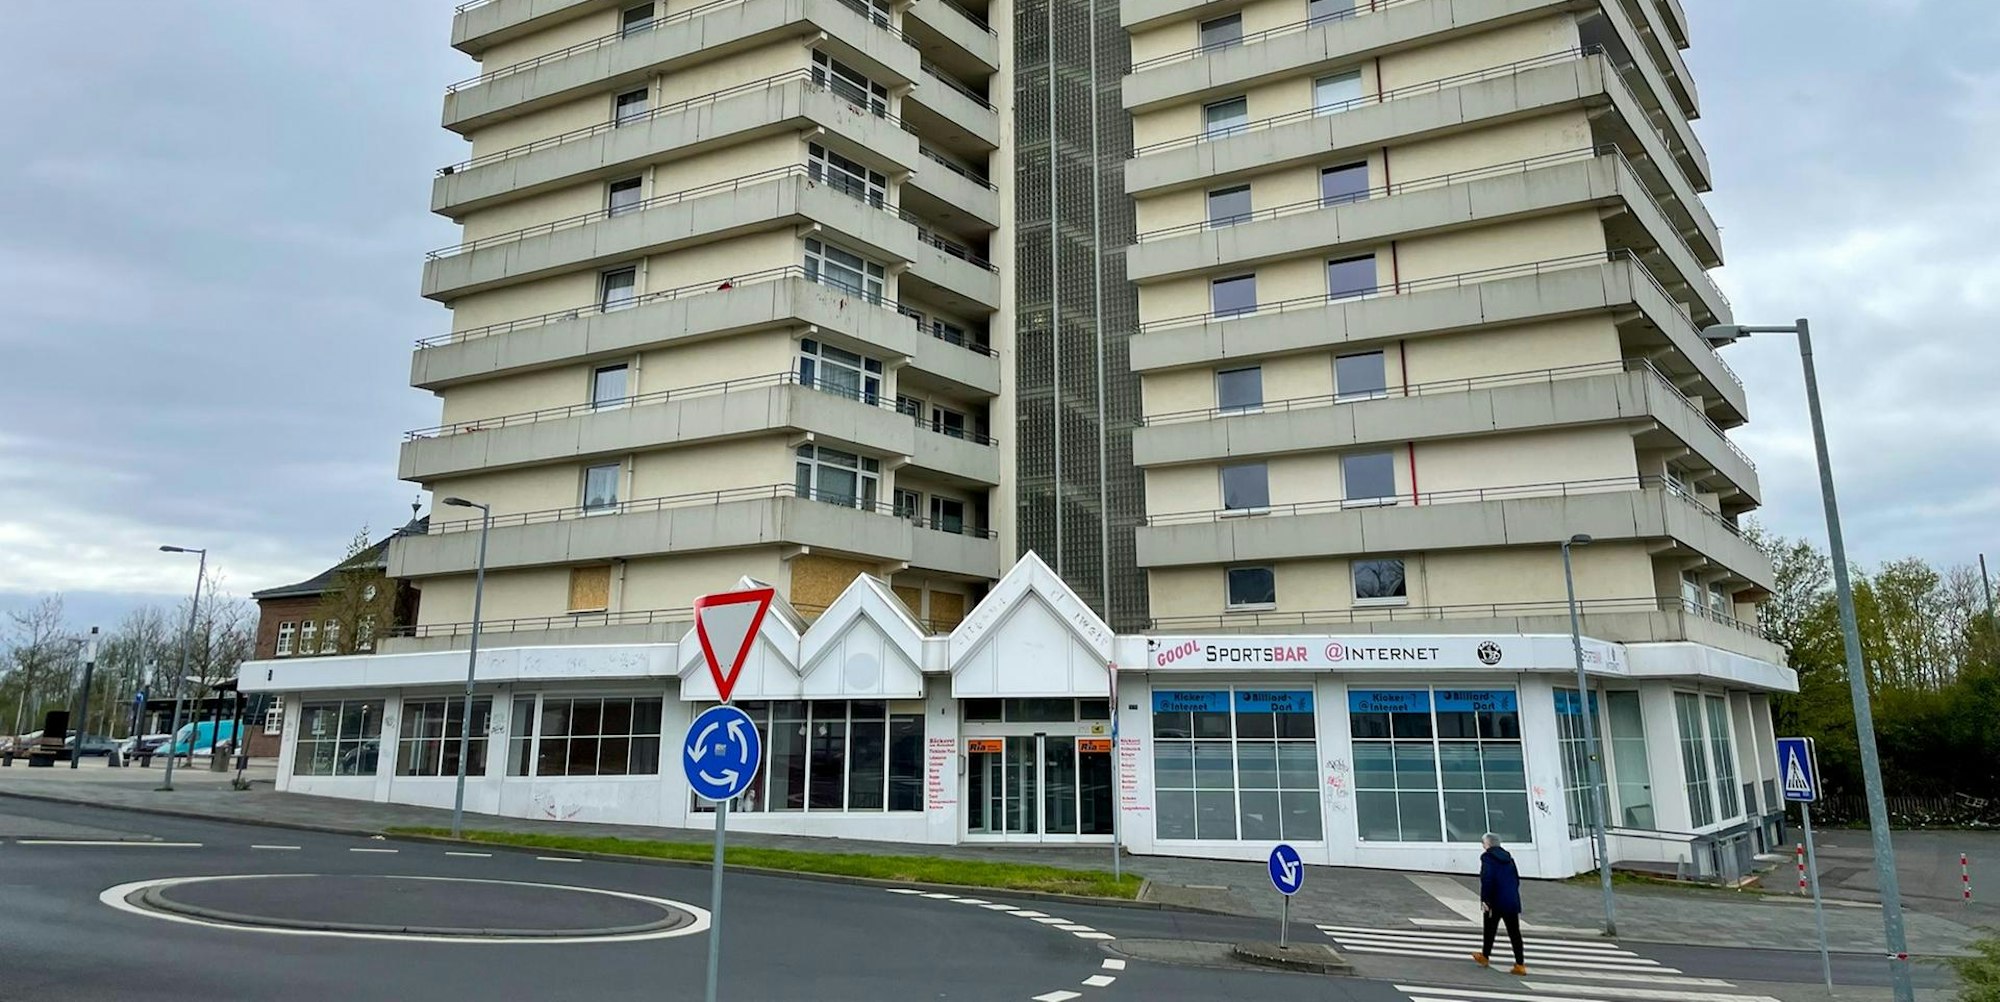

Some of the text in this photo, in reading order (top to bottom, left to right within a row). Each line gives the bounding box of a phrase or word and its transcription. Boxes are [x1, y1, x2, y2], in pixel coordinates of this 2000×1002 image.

[1157, 640, 1200, 666] GOOOL
[1271, 703, 1292, 711] Dart
[1473, 702, 1495, 710] Dart
[970, 741, 986, 751] Ria
[1080, 741, 1097, 751] Ria
